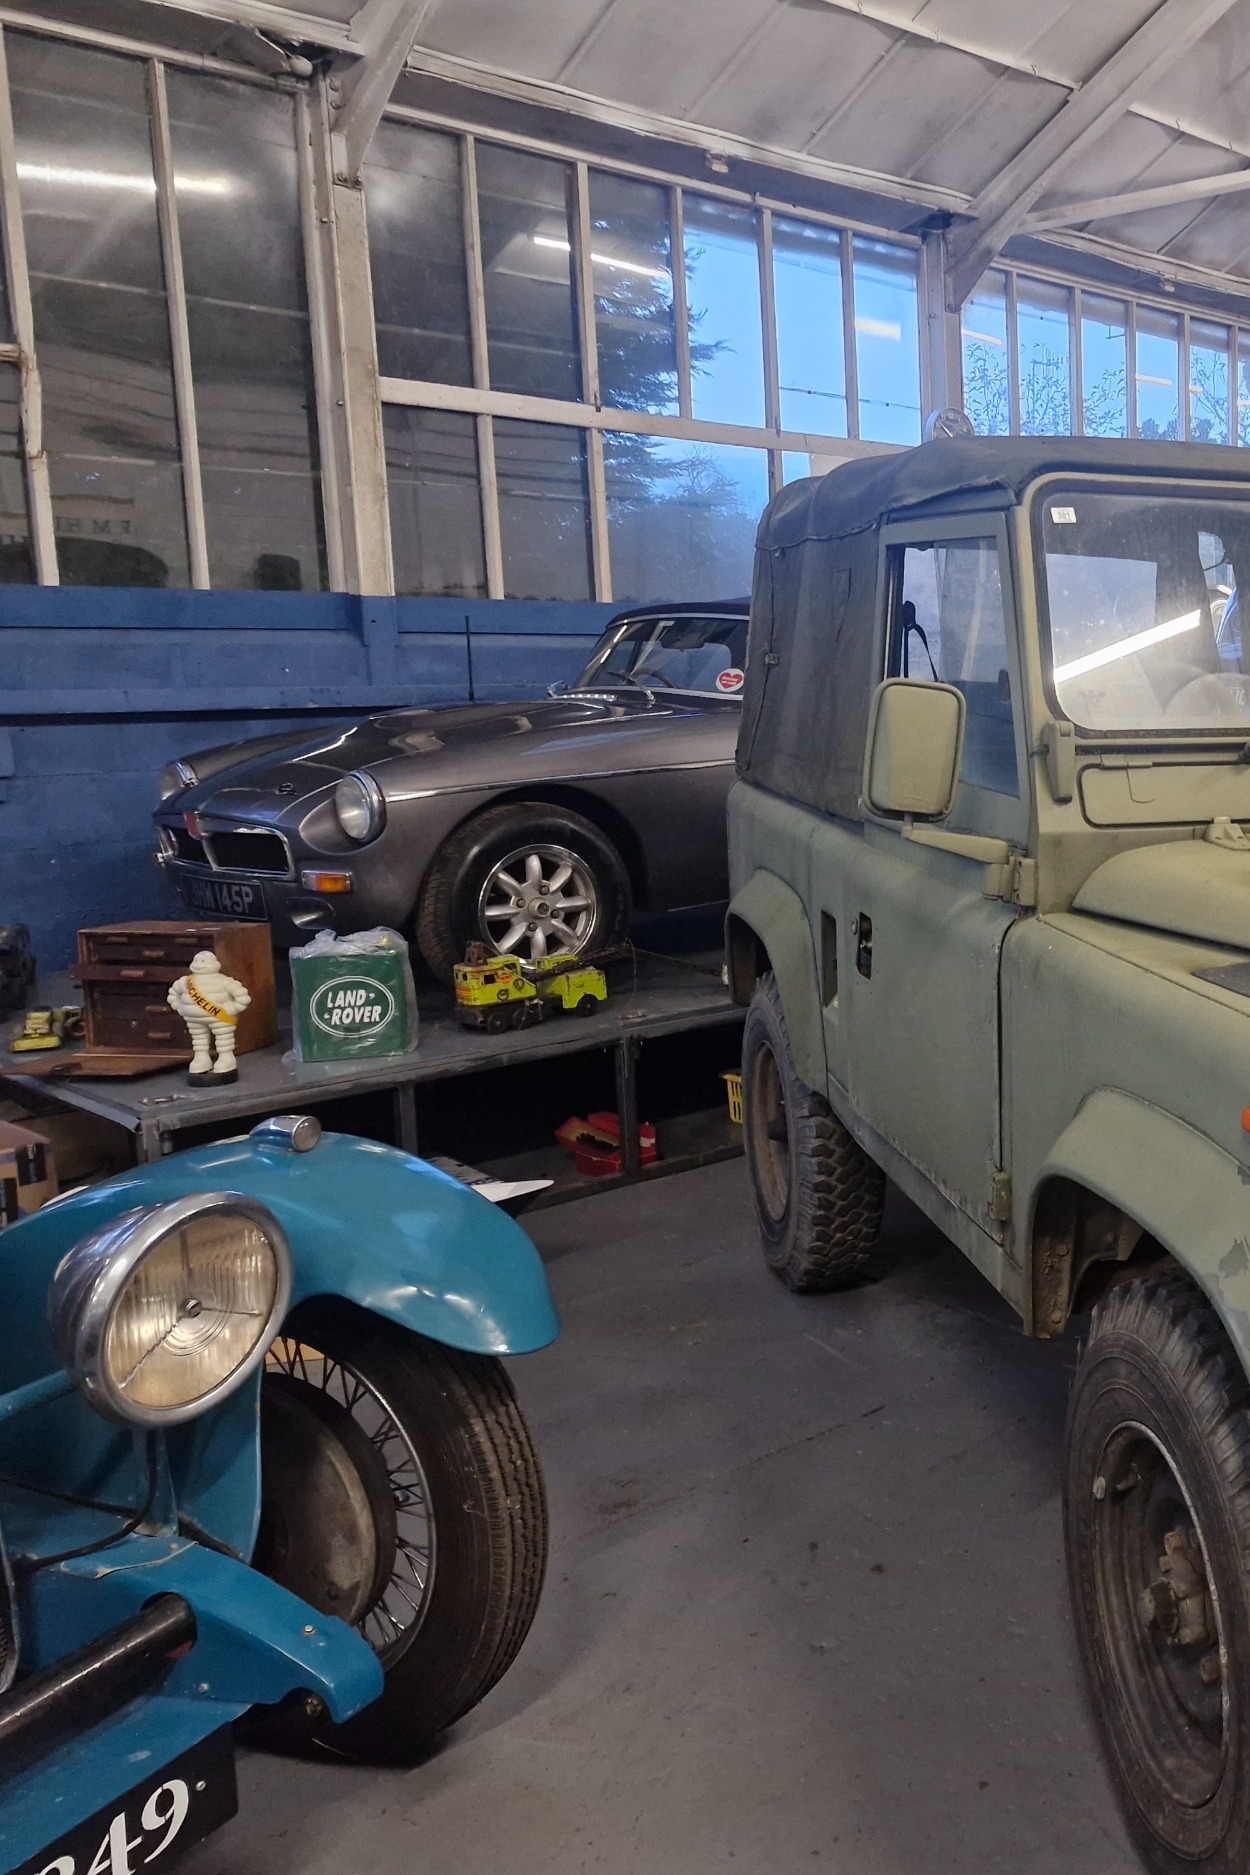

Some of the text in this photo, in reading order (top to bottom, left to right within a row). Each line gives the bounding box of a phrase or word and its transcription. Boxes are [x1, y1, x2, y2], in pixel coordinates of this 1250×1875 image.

[215, 883, 253, 914] 145P
[186, 978, 220, 1017] MICHELIN
[326, 989, 367, 1008] LAND
[330, 1005, 382, 1026] ROVER
[34, 1778, 190, 1875] 49
